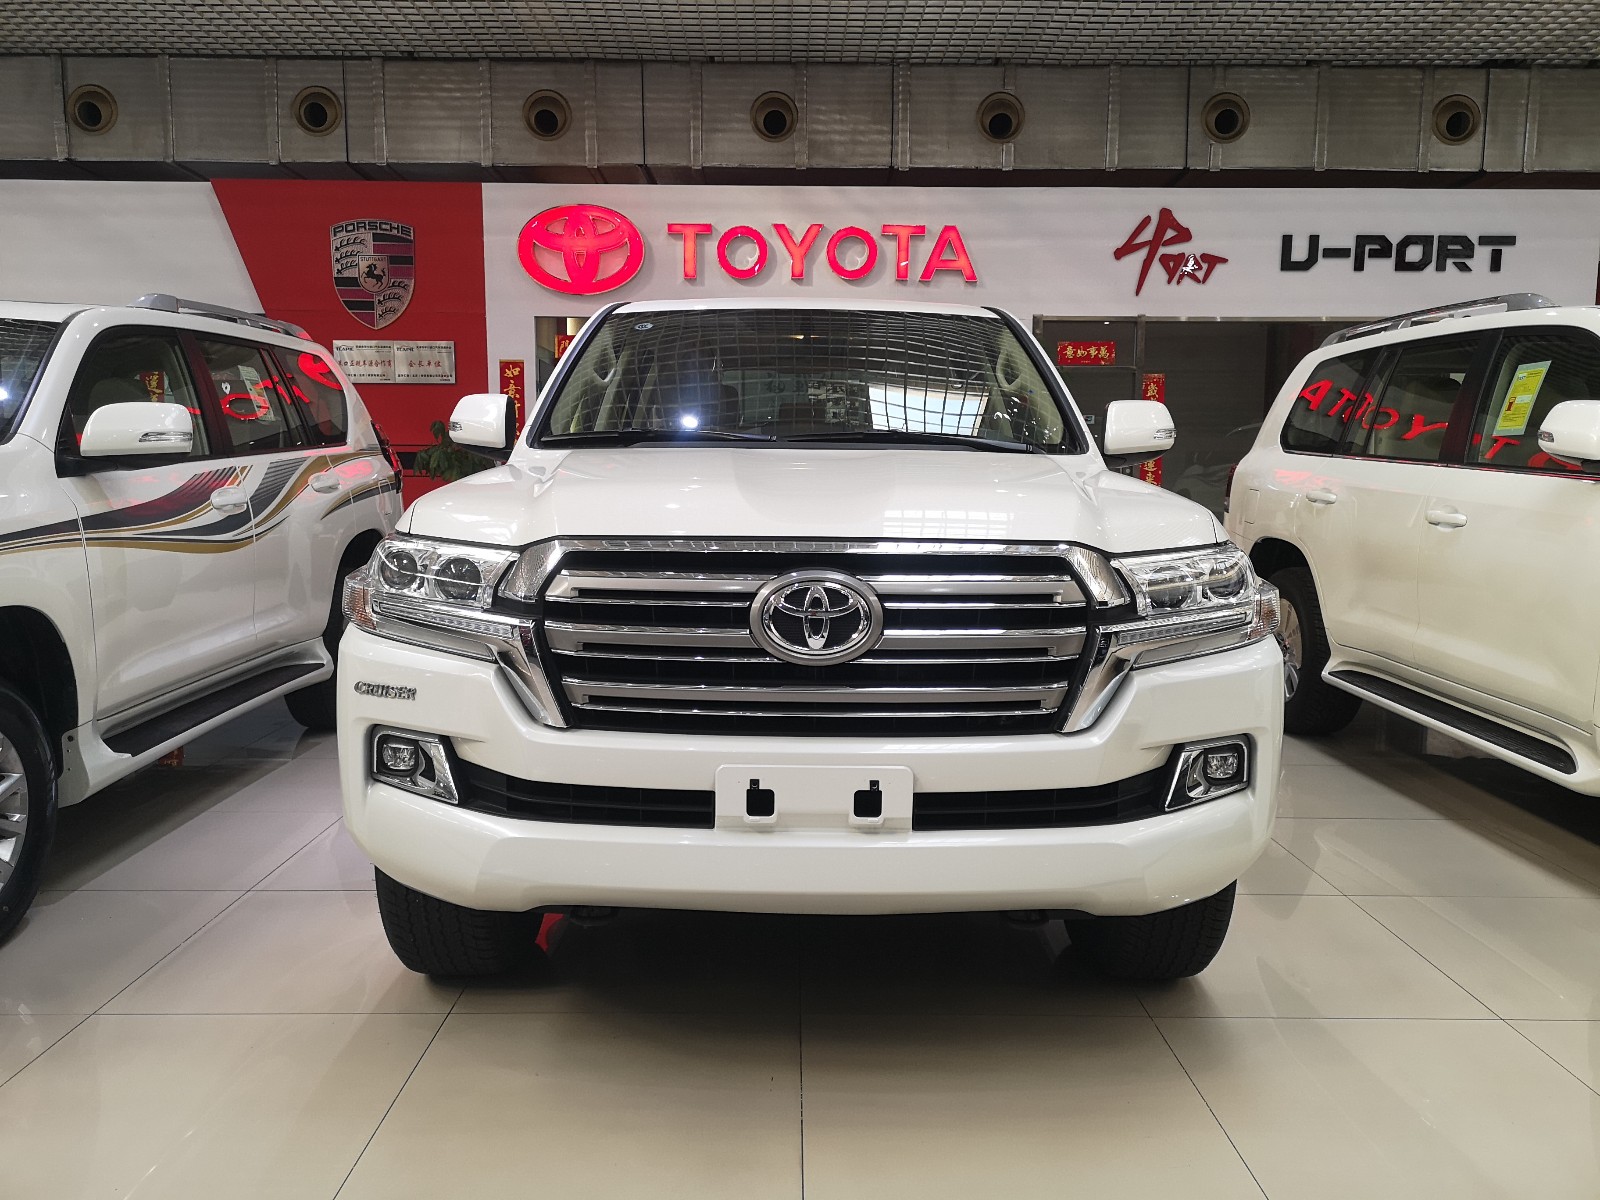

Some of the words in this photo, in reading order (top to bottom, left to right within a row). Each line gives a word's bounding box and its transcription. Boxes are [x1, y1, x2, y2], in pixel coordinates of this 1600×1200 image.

[333, 221, 412, 238] PORSCHE
[667, 223, 978, 282] TOYOTA
[1281, 234, 1517, 272] U-PORT
[353, 680, 417, 701] CRUISER
